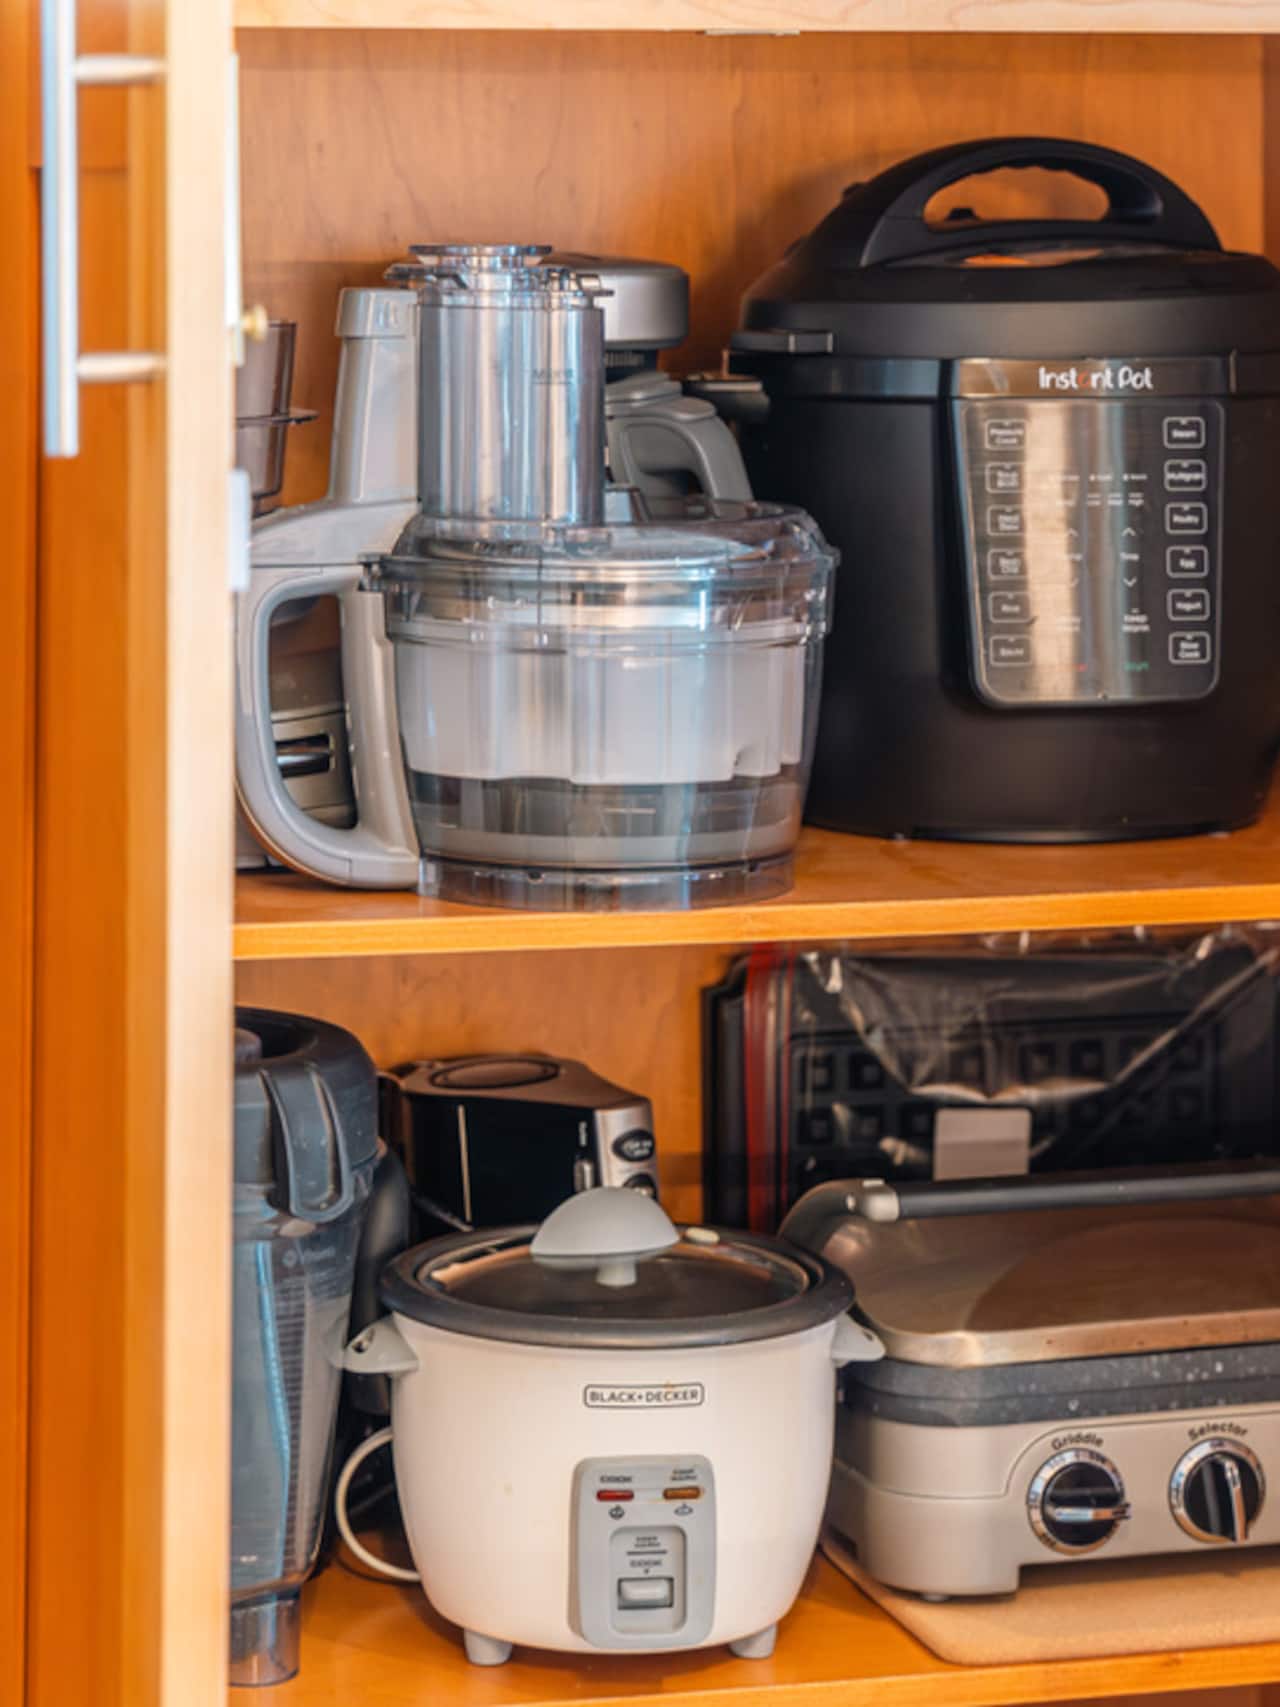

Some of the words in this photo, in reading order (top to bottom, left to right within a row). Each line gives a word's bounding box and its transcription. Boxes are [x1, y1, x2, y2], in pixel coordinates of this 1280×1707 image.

[1039, 365, 1114, 390] Instant
[1118, 365, 1154, 390] Pot
[589, 1389, 698, 1403] BLACK+DECKER
[1051, 1431, 1104, 1451] Griddle
[1187, 1422, 1249, 1441] Selector
